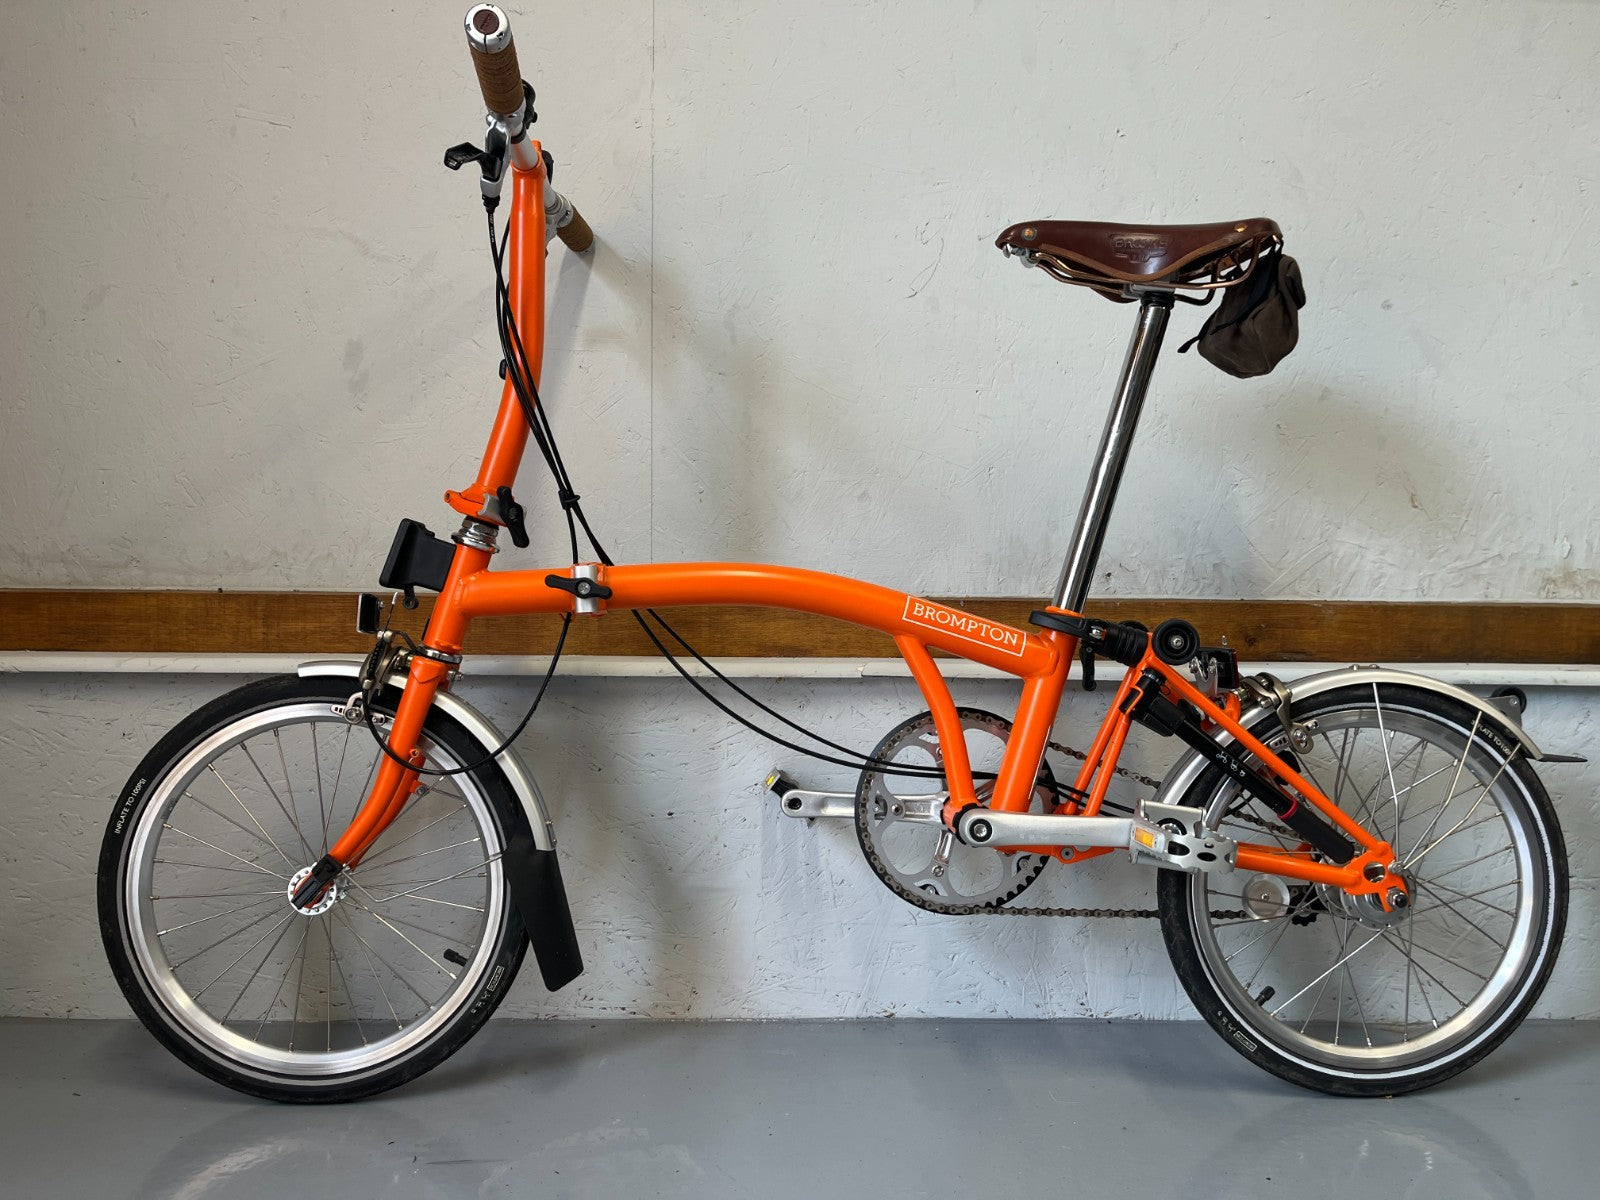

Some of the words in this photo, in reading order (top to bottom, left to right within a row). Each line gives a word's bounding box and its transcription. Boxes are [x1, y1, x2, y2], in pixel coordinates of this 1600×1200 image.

[913, 602, 1019, 646] BROMPTON
[1493, 736, 1502, 746] TO
[114, 807, 130, 834] INFLATE
[125, 796, 135, 806] TO
[131, 778, 147, 797] 100PSI
